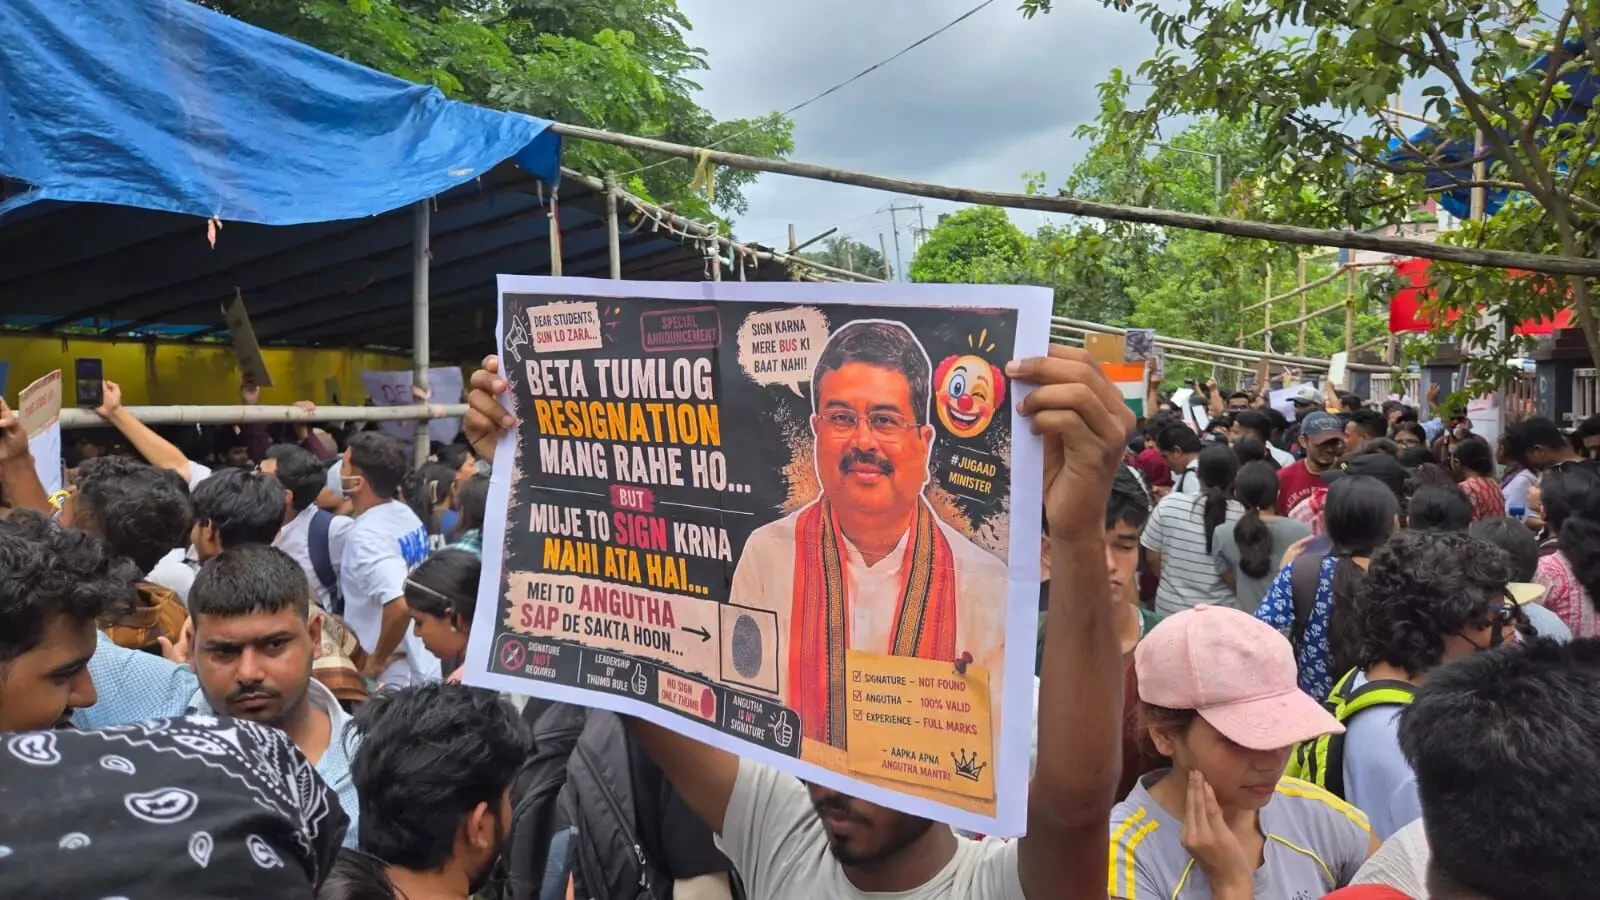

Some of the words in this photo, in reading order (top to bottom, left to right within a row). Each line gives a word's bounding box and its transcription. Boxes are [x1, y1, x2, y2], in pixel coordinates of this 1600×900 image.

[534, 314, 552, 327] DEAR
[554, 311, 595, 326] STUDENTS,
[662, 315, 698, 329] SPECIAL
[752, 322, 773, 336] SIGN
[774, 319, 807, 334] KARNA
[536, 330, 552, 344] SUN
[554, 329, 566, 342] LO
[568, 327, 598, 341] ZARA...
[647, 328, 717, 345] ANNOUNCEMENT
[752, 340, 777, 355] MERE
[779, 338, 798, 353] BUS
[800, 337, 810, 351] KI
[754, 359, 778, 373] BAAT
[781, 357, 807, 371] NAHI!
[525, 359, 588, 398] BETA
[594, 357, 713, 400] TUMLOG
[534, 400, 721, 446] RESIGNATION
[539, 438, 608, 480] MANG
[612, 444, 684, 486] RAHE
[690, 449, 751, 493] HO...
[950, 454, 996, 477] #JUGAAD
[948, 471, 992, 495] MINISTER
[619, 488, 644, 507] BUT
[529, 503, 584, 538] MUJE
[586, 509, 610, 542] TO
[613, 512, 668, 551] SIGN
[673, 521, 733, 562] KRNA
[543, 538, 599, 575] NAHI
[604, 545, 641, 583] ATA
[645, 553, 709, 595] HAI...
[527, 581, 552, 602] MEI
[556, 584, 574, 604] TO
[578, 585, 676, 629] ANGUTHA
[520, 603, 559, 630] SAP
[562, 613, 580, 633] DE
[584, 616, 630, 642] SAKTA
[634, 625, 683, 656] HOON...
[528, 641, 561, 656] SIGNATURE
[532, 654, 552, 667] NOT
[594, 653, 631, 669] LEADERSHIP
[525, 664, 557, 678] REQUIRED
[605, 666, 615, 677] BY
[586, 673, 611, 688] THUMB
[611, 678, 629, 692] RULE
[666, 678, 676, 690] NO
[677, 681, 693, 694] SIGN
[864, 673, 906, 686] SIGNATURE
[918, 677, 935, 688] NOT
[938, 678, 966, 692] FOUND
[661, 689, 676, 702] ONLY
[677, 693, 700, 711] THUMB
[732, 695, 763, 713] ANGUTHA
[865, 693, 902, 705] ANGUTHA
[920, 697, 943, 710] 100%
[945, 701, 971, 713] VALID
[737, 708, 744, 720] IS
[745, 711, 757, 723] MY
[866, 712, 912, 726] EXPERIENCE
[923, 717, 944, 730] FULL
[946, 720, 978, 735] MARKS
[730, 718, 766, 741] SIGNATURE
[891, 746, 916, 760] AAPKA
[918, 752, 940, 765] APNA
[881, 759, 918, 775] ANGUTHA
